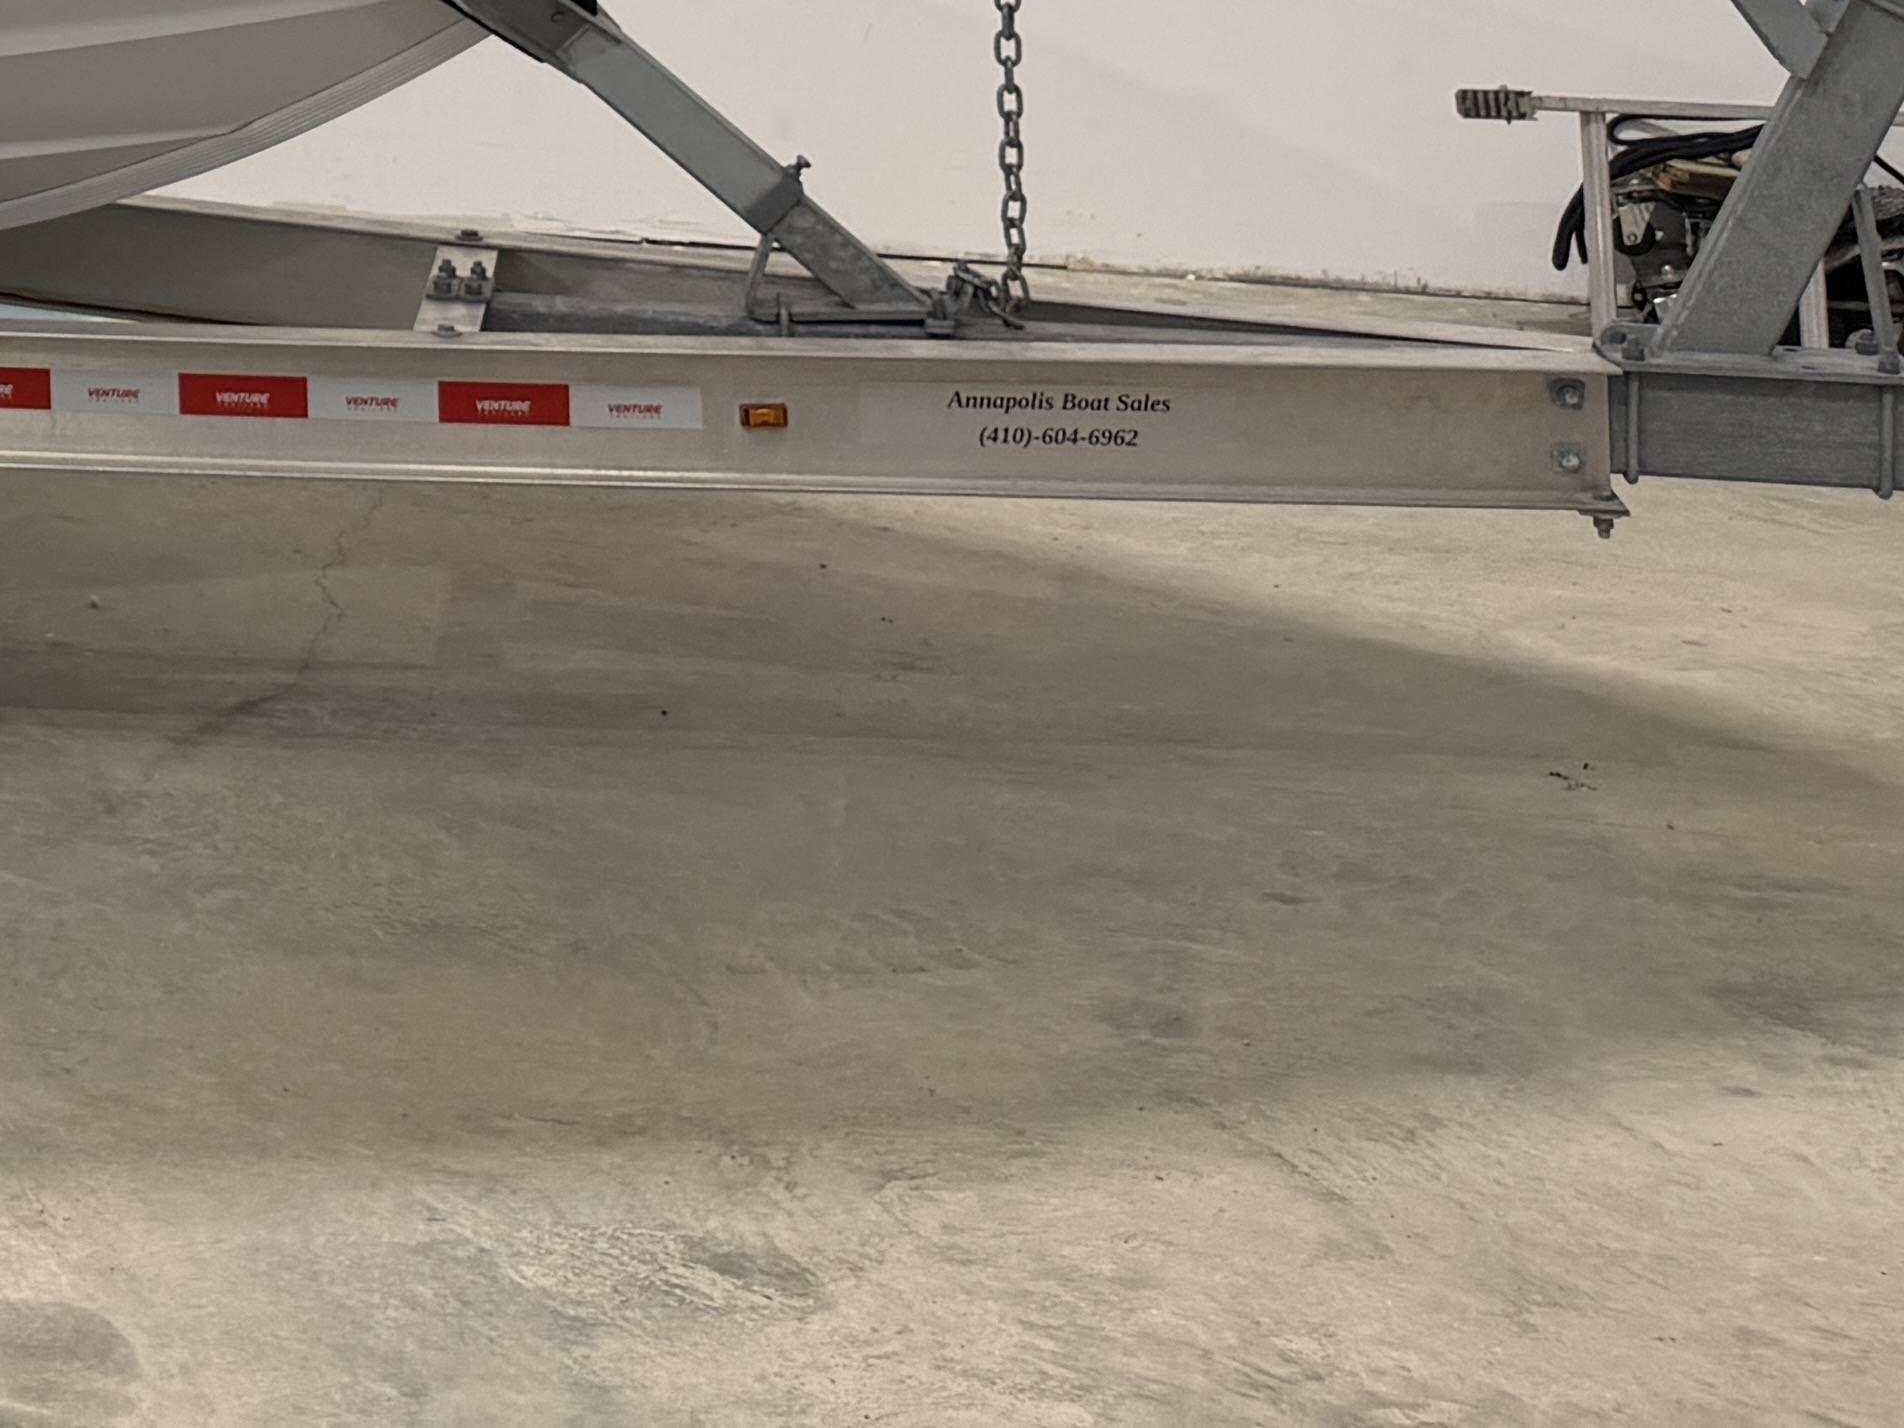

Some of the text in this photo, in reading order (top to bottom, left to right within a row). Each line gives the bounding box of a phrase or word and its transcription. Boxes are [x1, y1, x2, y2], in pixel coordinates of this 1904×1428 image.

[87, 388, 141, 399] VENTURE
[215, 392, 270, 404] VENTURE
[345, 396, 400, 408] VENTURE
[475, 399, 531, 412] VENTURE
[947, 390, 1171, 414] Annapolis Boat Sales
[607, 403, 663, 415] VENTURE
[978, 425, 1139, 449] (410)-604-6962
